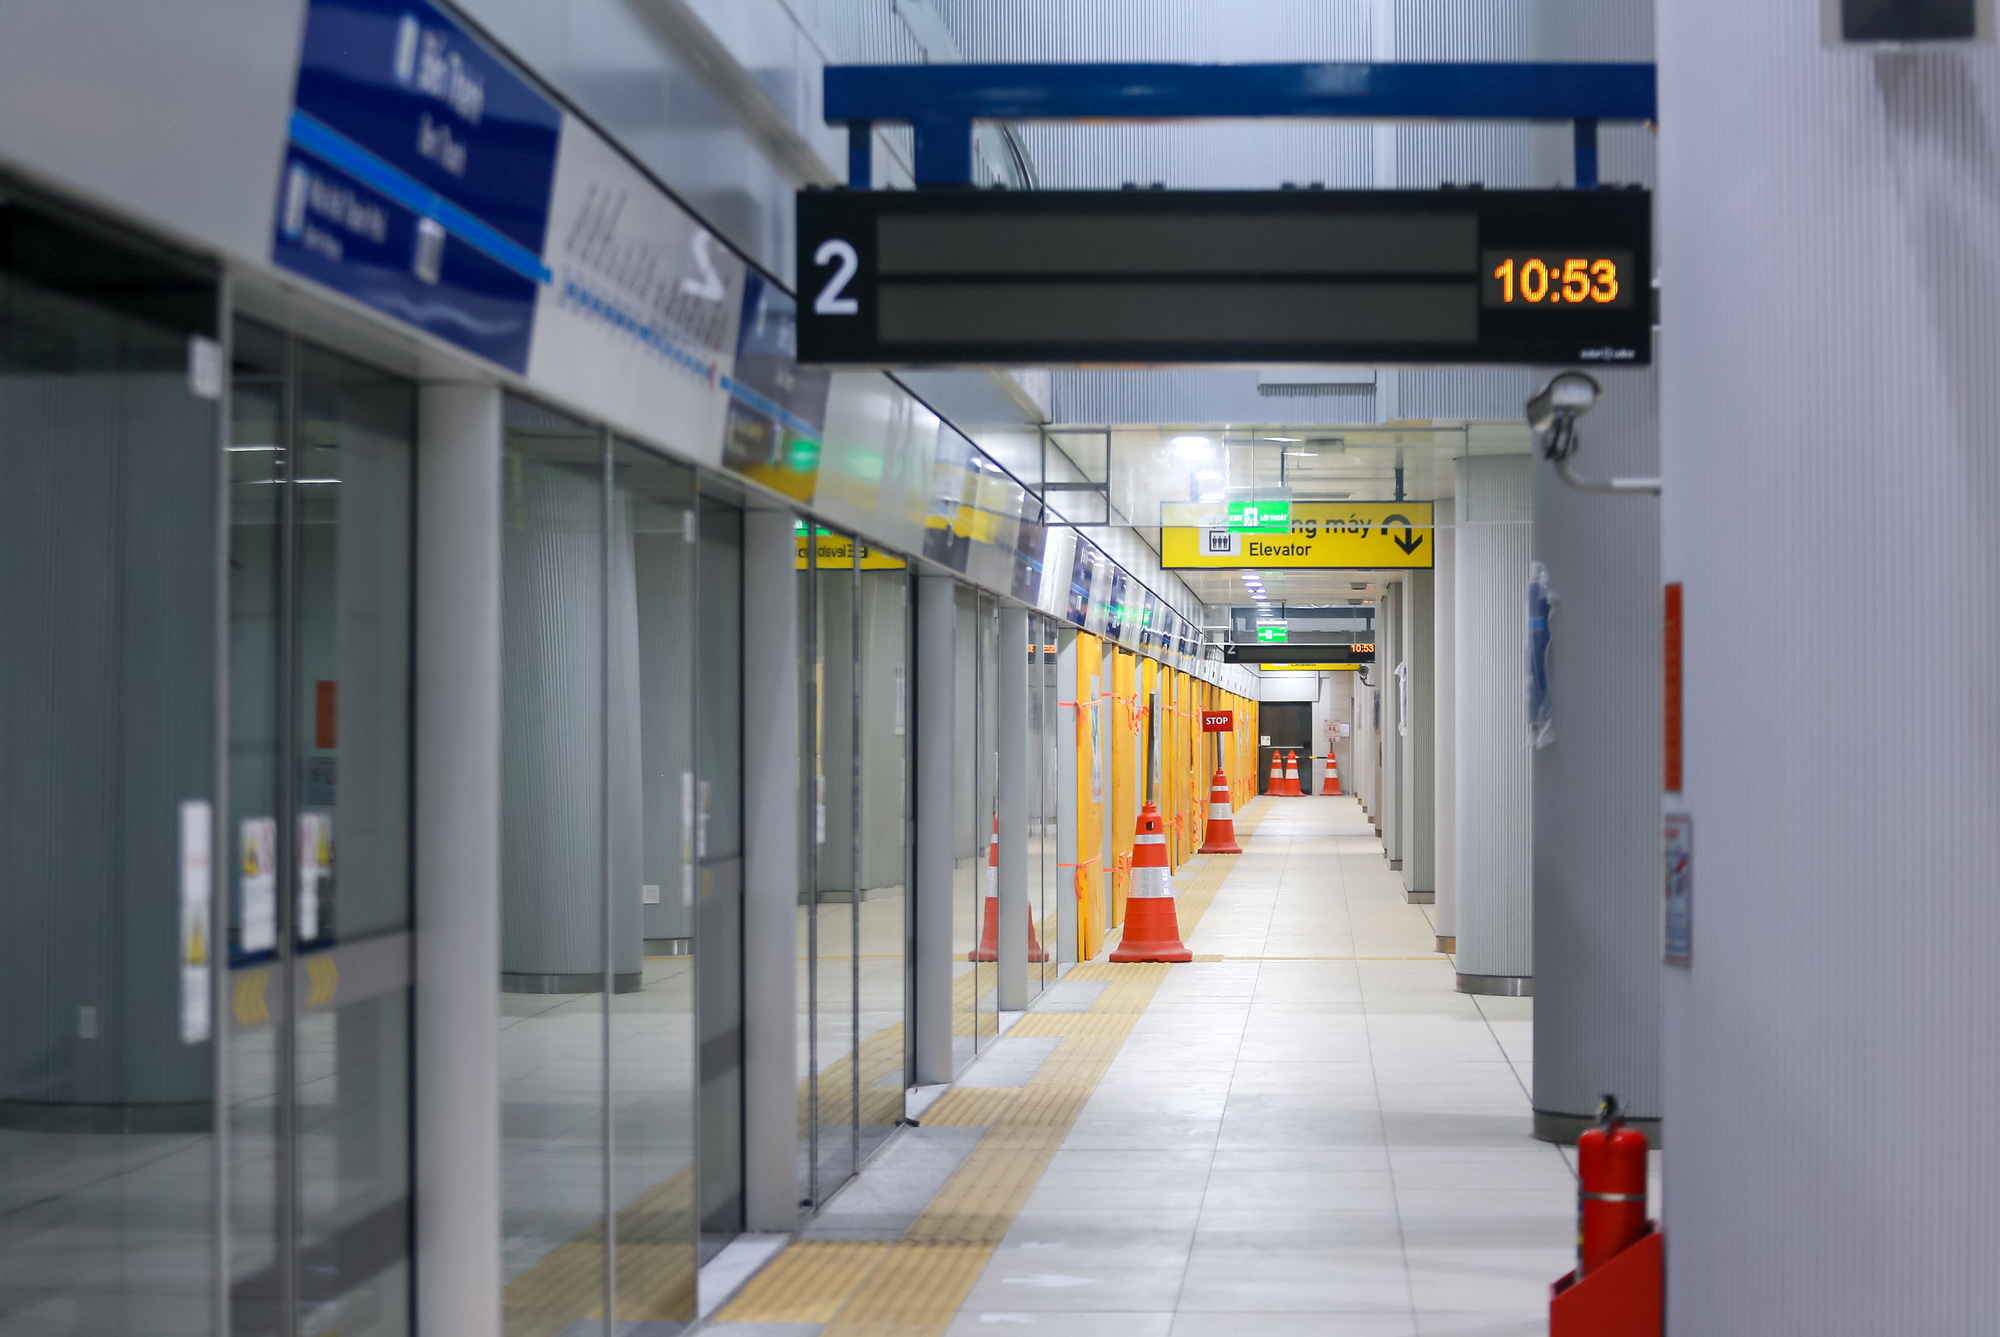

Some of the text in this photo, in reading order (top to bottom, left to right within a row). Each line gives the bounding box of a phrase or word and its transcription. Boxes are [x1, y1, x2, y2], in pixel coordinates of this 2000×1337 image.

[814, 237, 859, 315] 2
[1494, 258, 1619, 303] 10:53
[1325, 513, 1372, 539] máy
[1249, 542, 1312, 557] Elevator
[1350, 643, 1375, 653] 10:53
[1205, 716, 1229, 725] STOP
